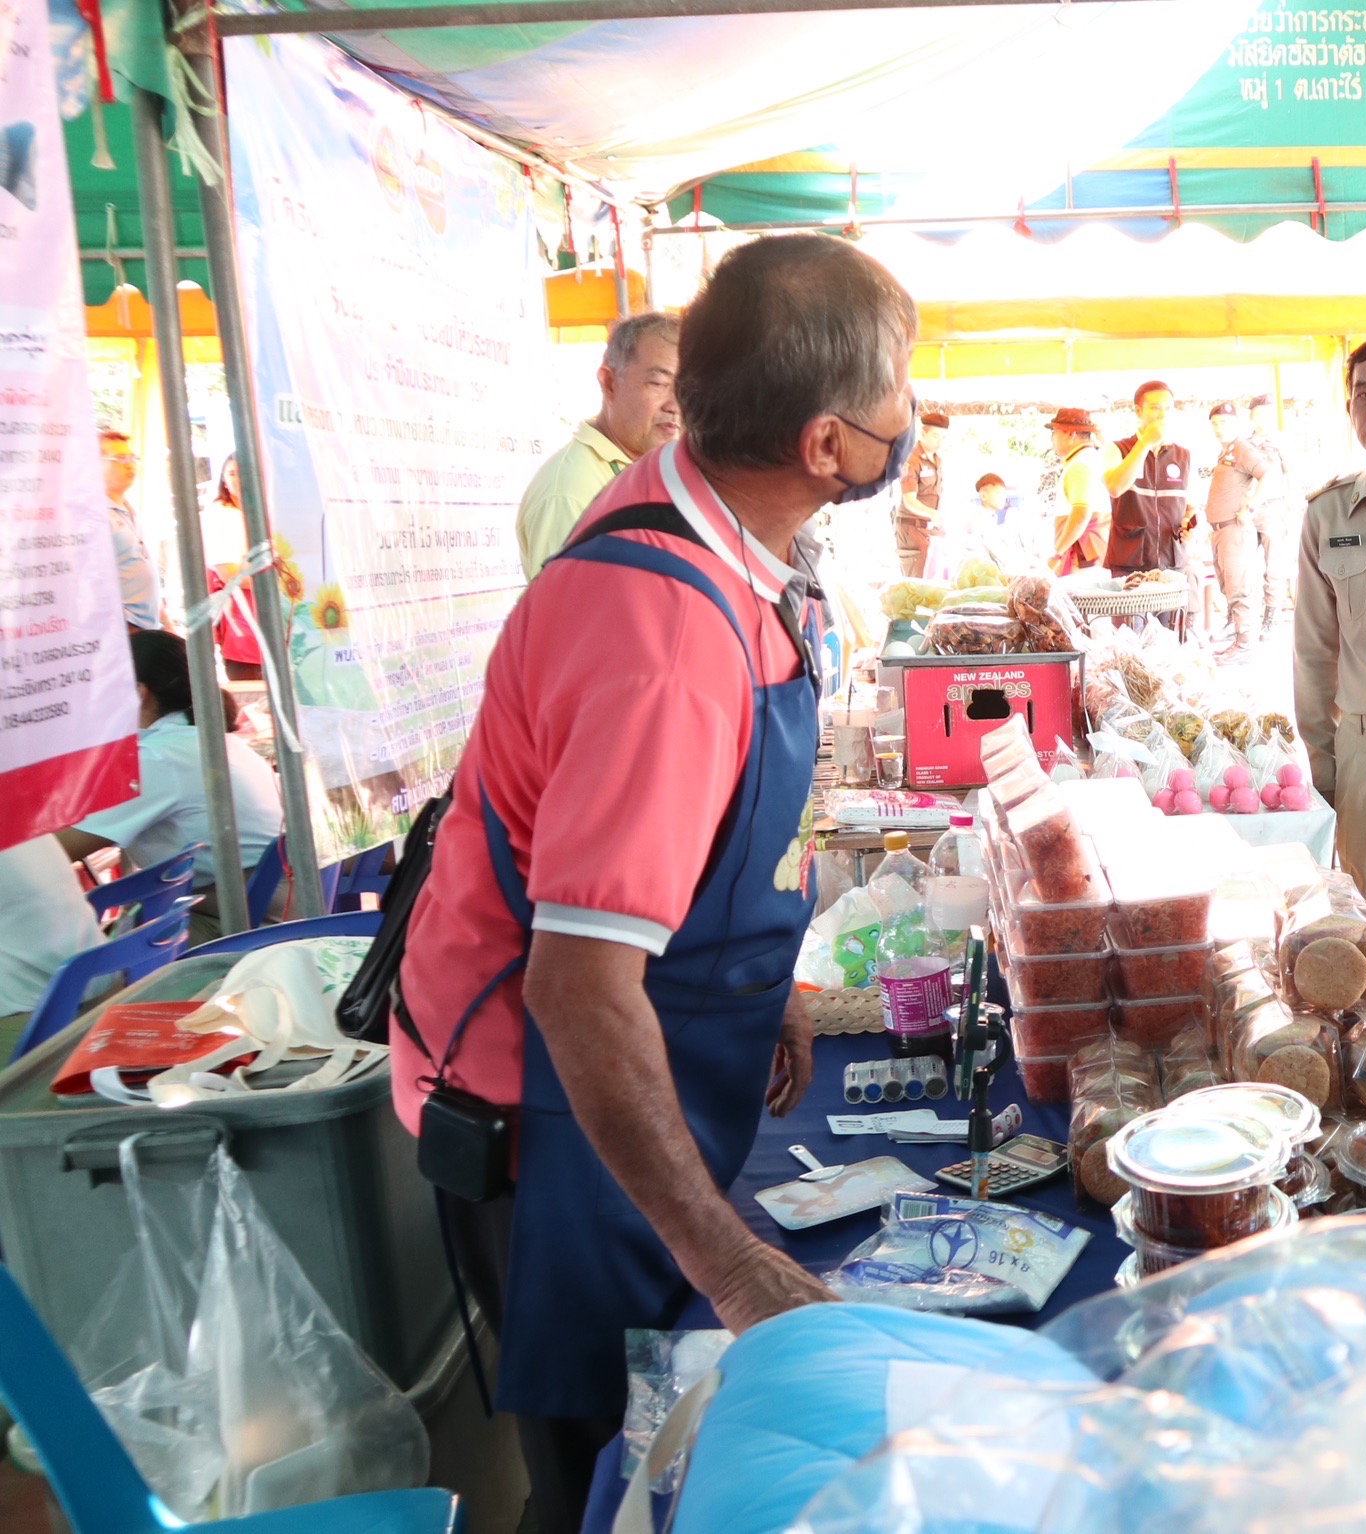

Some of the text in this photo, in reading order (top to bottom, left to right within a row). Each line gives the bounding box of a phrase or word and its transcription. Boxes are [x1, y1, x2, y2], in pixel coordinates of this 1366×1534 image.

[1240, 71, 1362, 109] หมู่ 1 ต.เกาะไร่
[420, 528, 431, 548] 15
[953, 671, 1025, 682] NEW ZEALAND
[988, 1249, 1006, 1267] 16
[1020, 1262, 1031, 1273] 8
